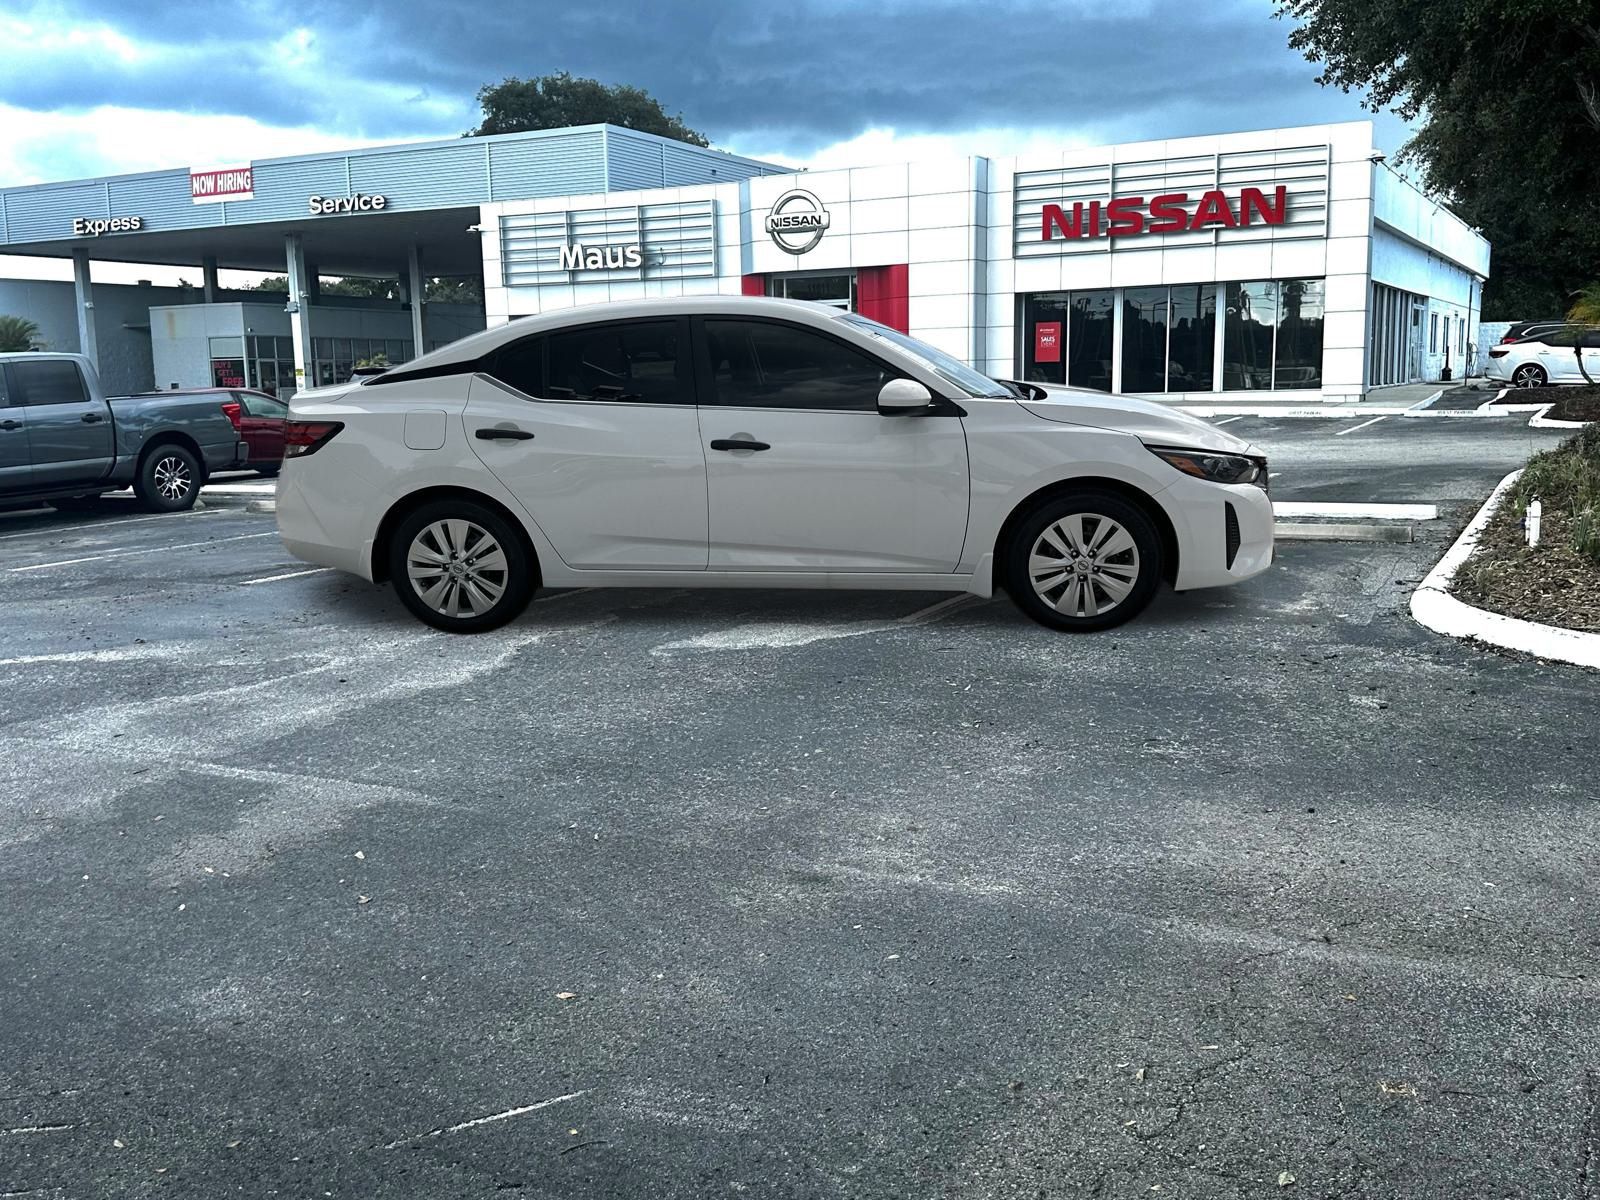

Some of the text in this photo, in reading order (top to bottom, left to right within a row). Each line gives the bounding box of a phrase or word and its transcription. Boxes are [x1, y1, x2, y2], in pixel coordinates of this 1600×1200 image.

[192, 171, 251, 195] NOW HIRING
[309, 193, 385, 215] Service
[1042, 185, 1287, 241] NISSAN
[73, 216, 141, 236] Express
[770, 214, 822, 228] NISSAN
[559, 243, 642, 270] Maus
[222, 377, 244, 386] FREE
